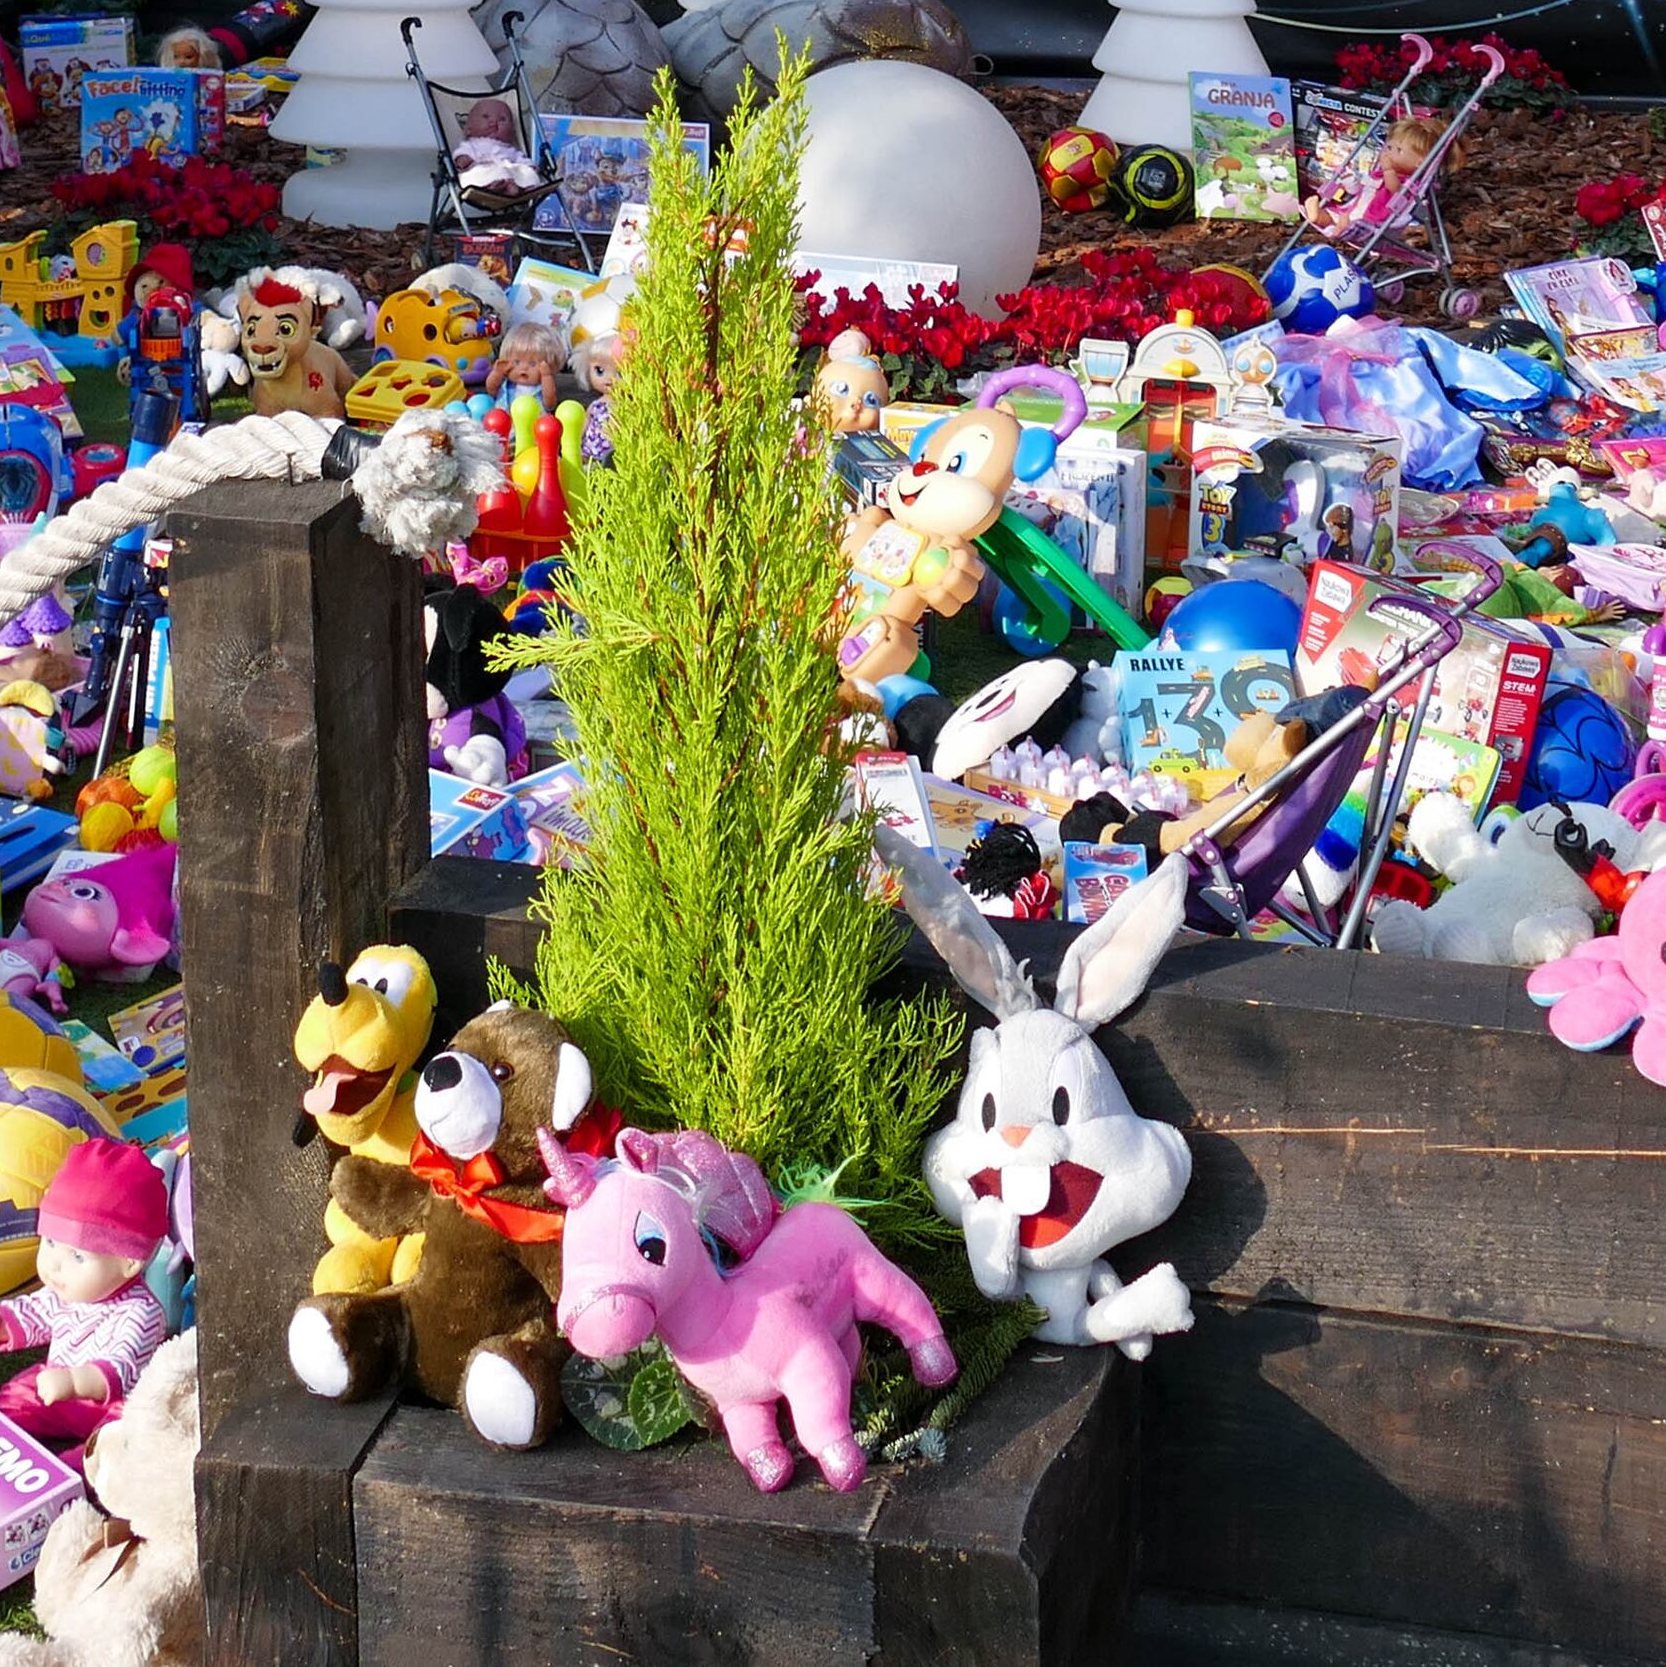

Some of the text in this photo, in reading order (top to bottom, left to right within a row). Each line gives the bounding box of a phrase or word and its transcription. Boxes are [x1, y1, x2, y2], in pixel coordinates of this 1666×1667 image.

[1208, 88, 1276, 108] GRANJA
[1198, 483, 1235, 505] TOY
[1373, 486, 1395, 505] TOY
[1130, 658, 1185, 672] RALLYE
[1502, 681, 1537, 695] STEM
